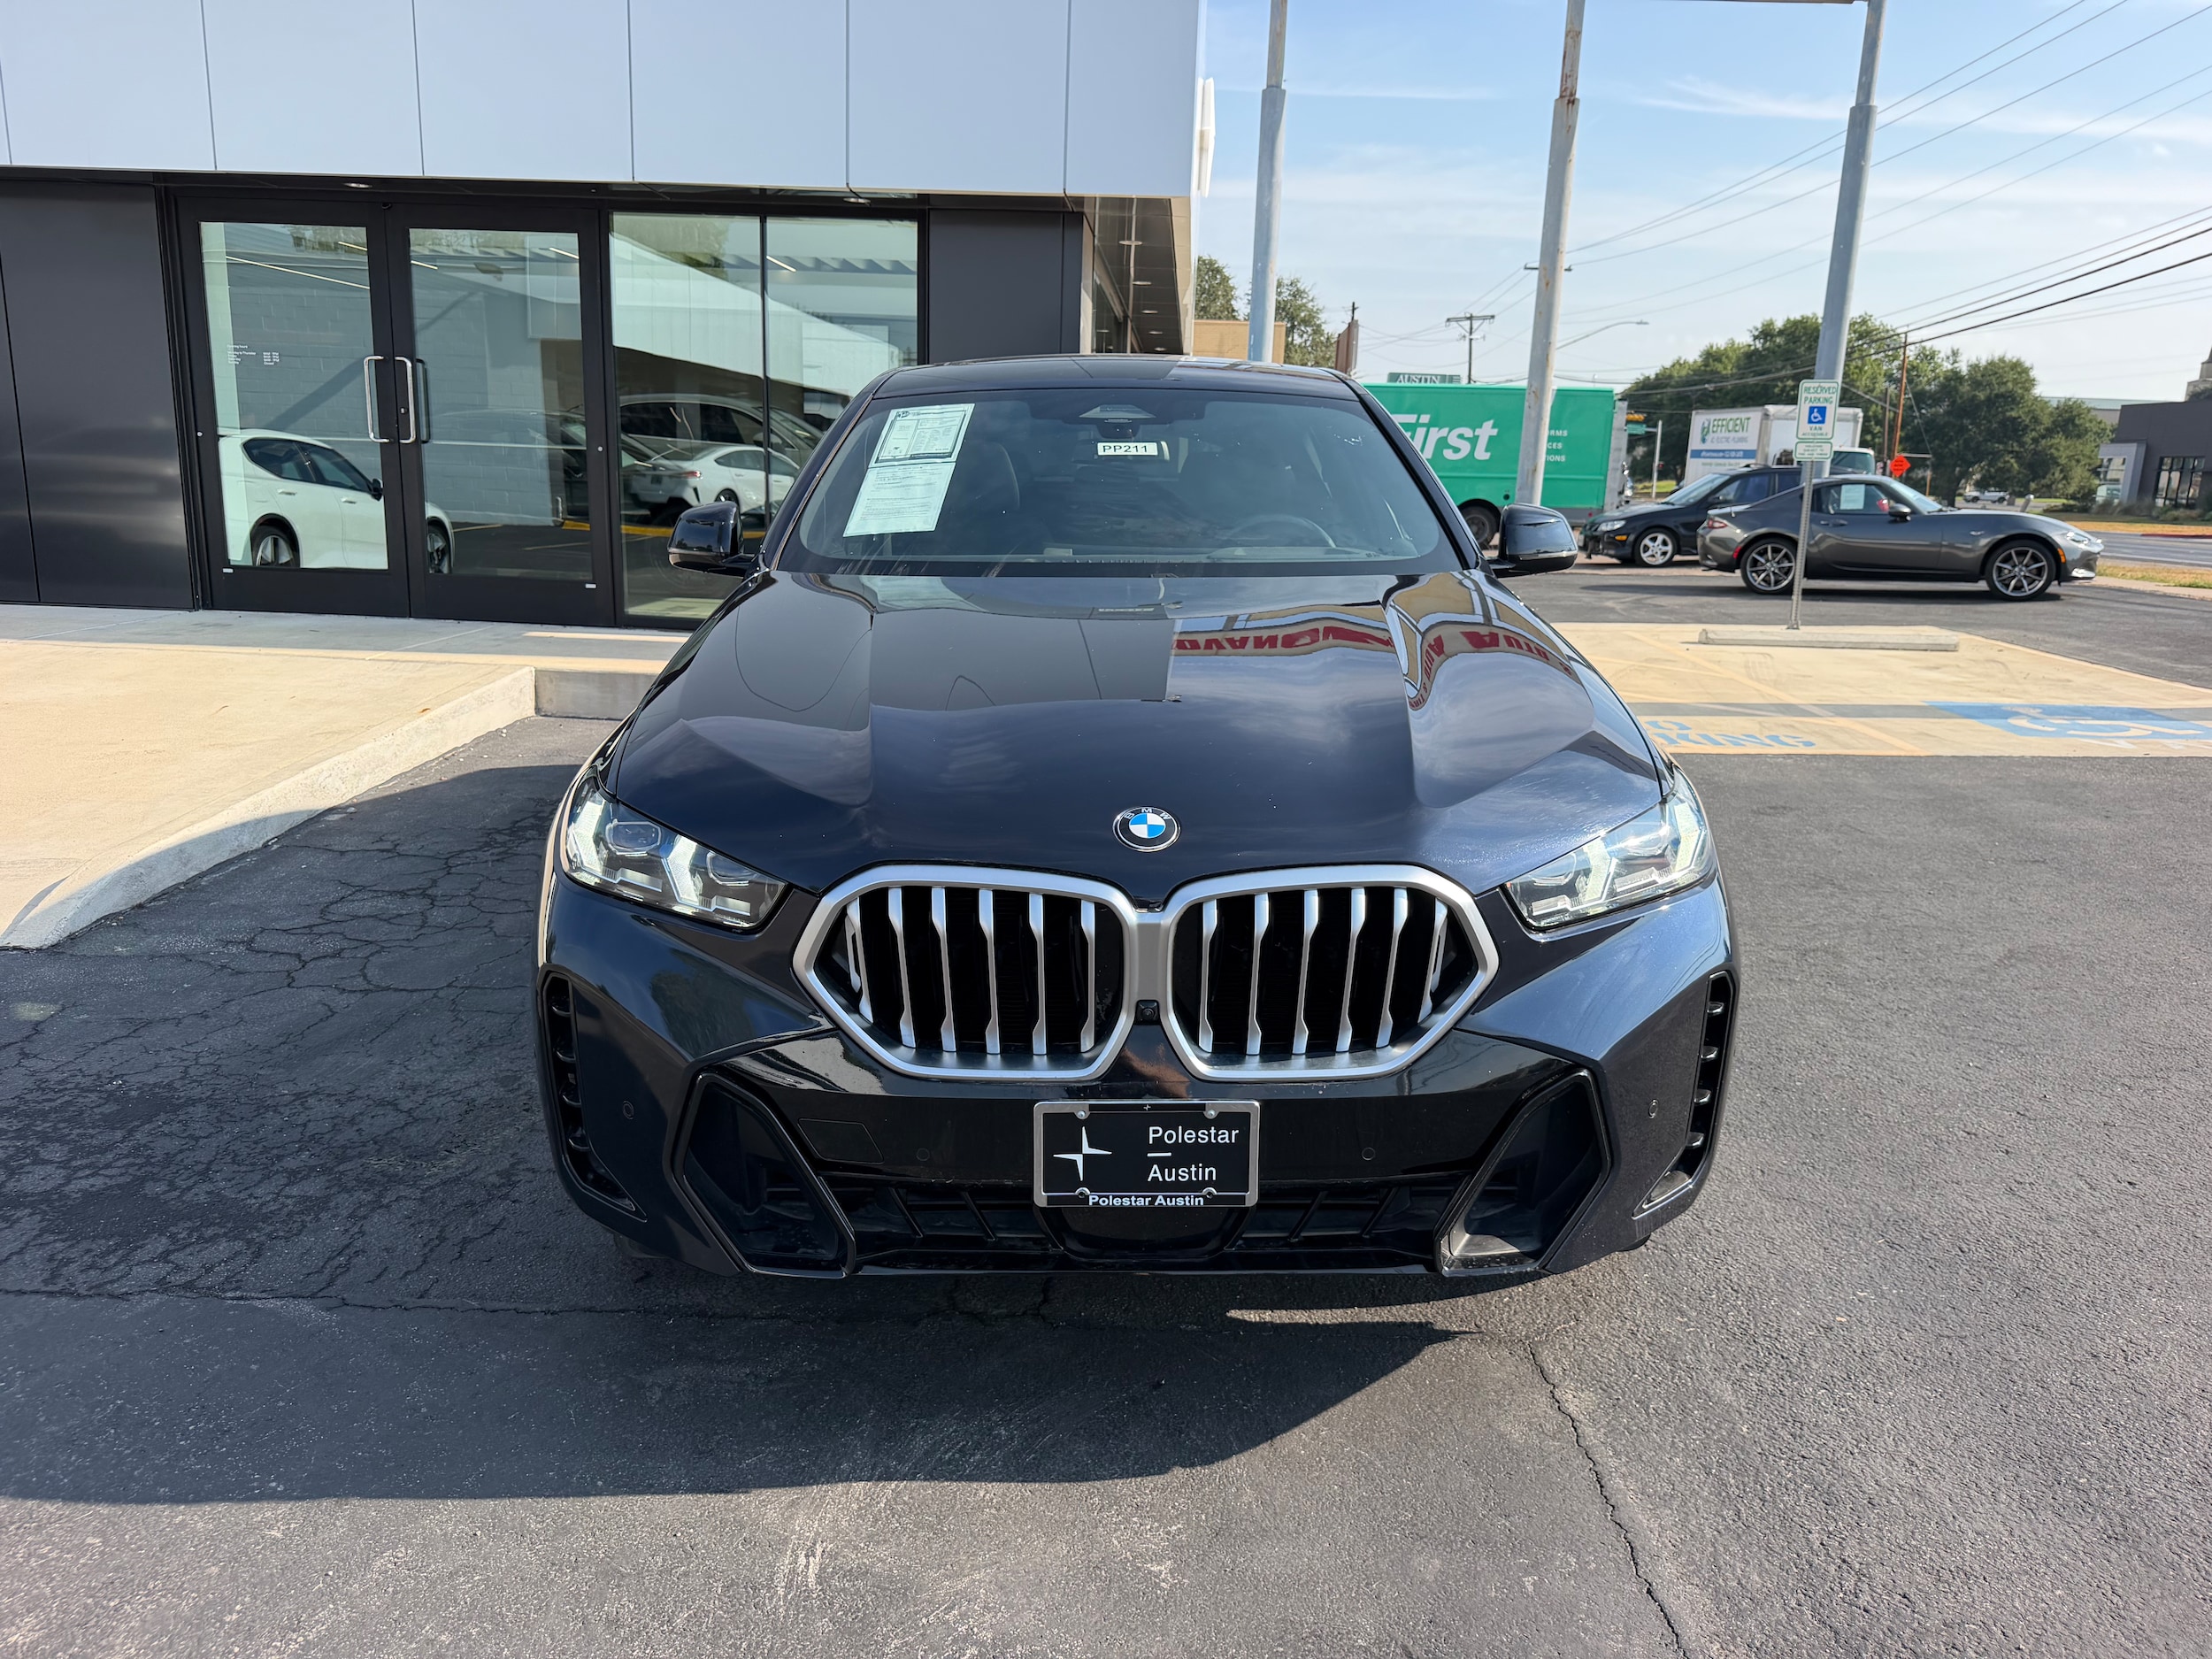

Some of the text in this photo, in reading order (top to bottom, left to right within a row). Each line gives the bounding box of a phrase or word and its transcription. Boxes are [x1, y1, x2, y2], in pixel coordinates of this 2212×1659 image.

[1396, 374, 1440, 384] AUSTIN
[1712, 417, 1751, 434] EFFICIENT
[1645, 720, 1693, 731] O
[1654, 733, 1816, 747] KING
[1124, 808, 1171, 819] BMW
[1148, 1125, 1239, 1144] Polestar
[1148, 1164, 1217, 1181] Austin
[1088, 1194, 1204, 1206] Polestar Austin
